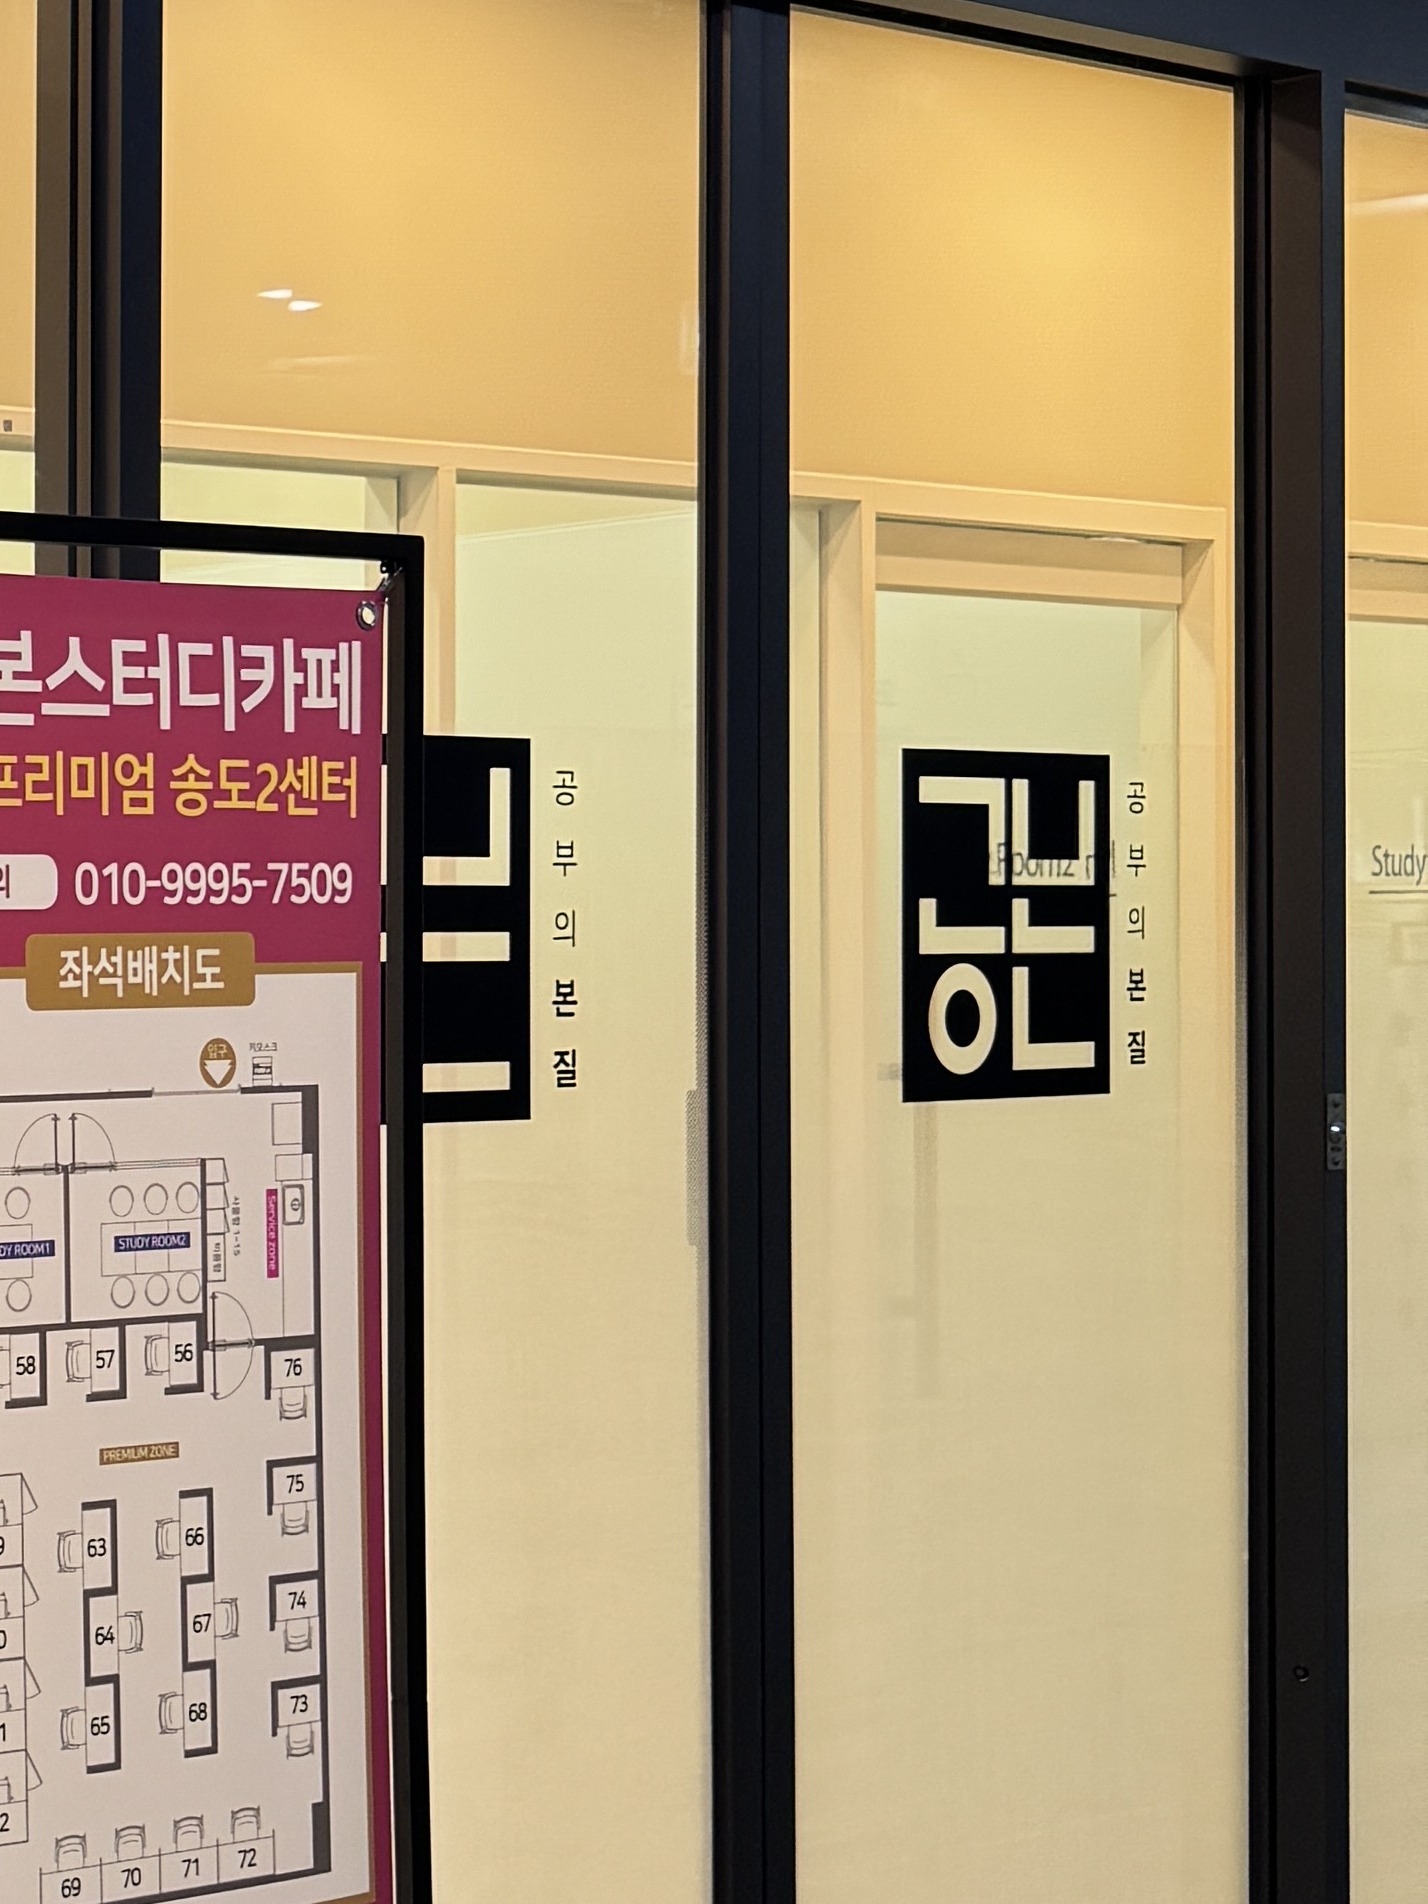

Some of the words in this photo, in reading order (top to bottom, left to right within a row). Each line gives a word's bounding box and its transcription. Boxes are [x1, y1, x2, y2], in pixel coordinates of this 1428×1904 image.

[170, 754, 358, 819] 송도2센터
[1371, 844, 1428, 885] Study
[75, 861, 353, 906] 010-9995-7509
[58, 947, 225, 997] 좌석배치도
[267, 1196, 276, 1240] Service
[14, 1242, 50, 1257] ROOM1
[119, 1235, 150, 1250] STUDY
[151, 1233, 186, 1248] ROOM2
[268, 1242, 276, 1271] zone
[96, 1350, 115, 1369] 57
[174, 1344, 193, 1362] 56
[16, 1356, 35, 1375] 58
[284, 1359, 303, 1377] 76
[103, 1446, 148, 1463] PREMIUM
[150, 1443, 177, 1460] ZONE
[286, 1474, 305, 1494] 75
[185, 1527, 205, 1546] 66
[87, 1538, 106, 1557] 63
[288, 1591, 308, 1611] 74
[193, 1614, 212, 1633] 67
[95, 1626, 115, 1645] 64
[189, 1702, 208, 1722] 68
[290, 1695, 310, 1714] 73
[90, 1716, 110, 1735] 65
[181, 1858, 201, 1878] 71
[238, 1849, 257, 1868] 72
[121, 1868, 141, 1887] 70
[61, 1878, 80, 1897] 69
